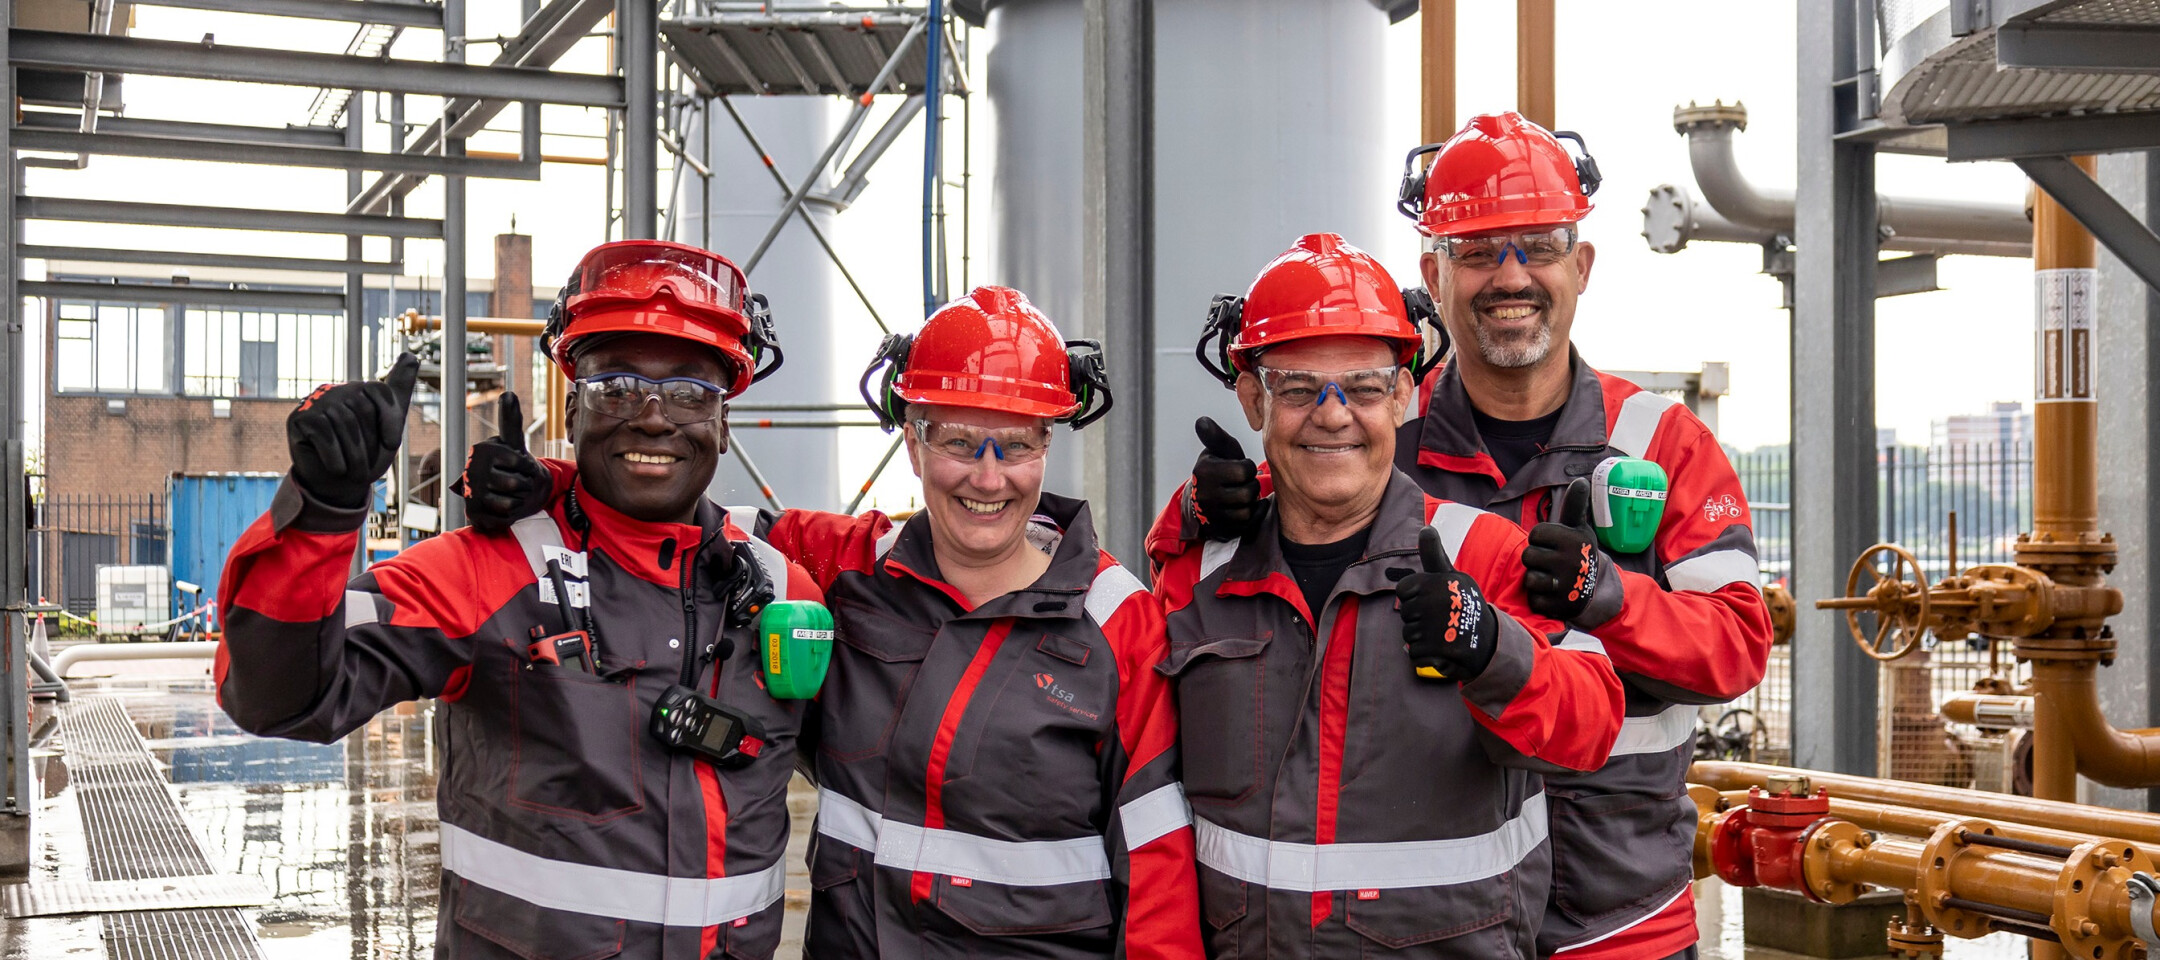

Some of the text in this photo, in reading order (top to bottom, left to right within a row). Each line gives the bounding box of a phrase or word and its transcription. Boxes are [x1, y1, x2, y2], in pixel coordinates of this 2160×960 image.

[1568, 543, 1592, 601] OXXA
[1444, 580, 1462, 642] OXXA
[1051, 684, 1075, 702] tsa
